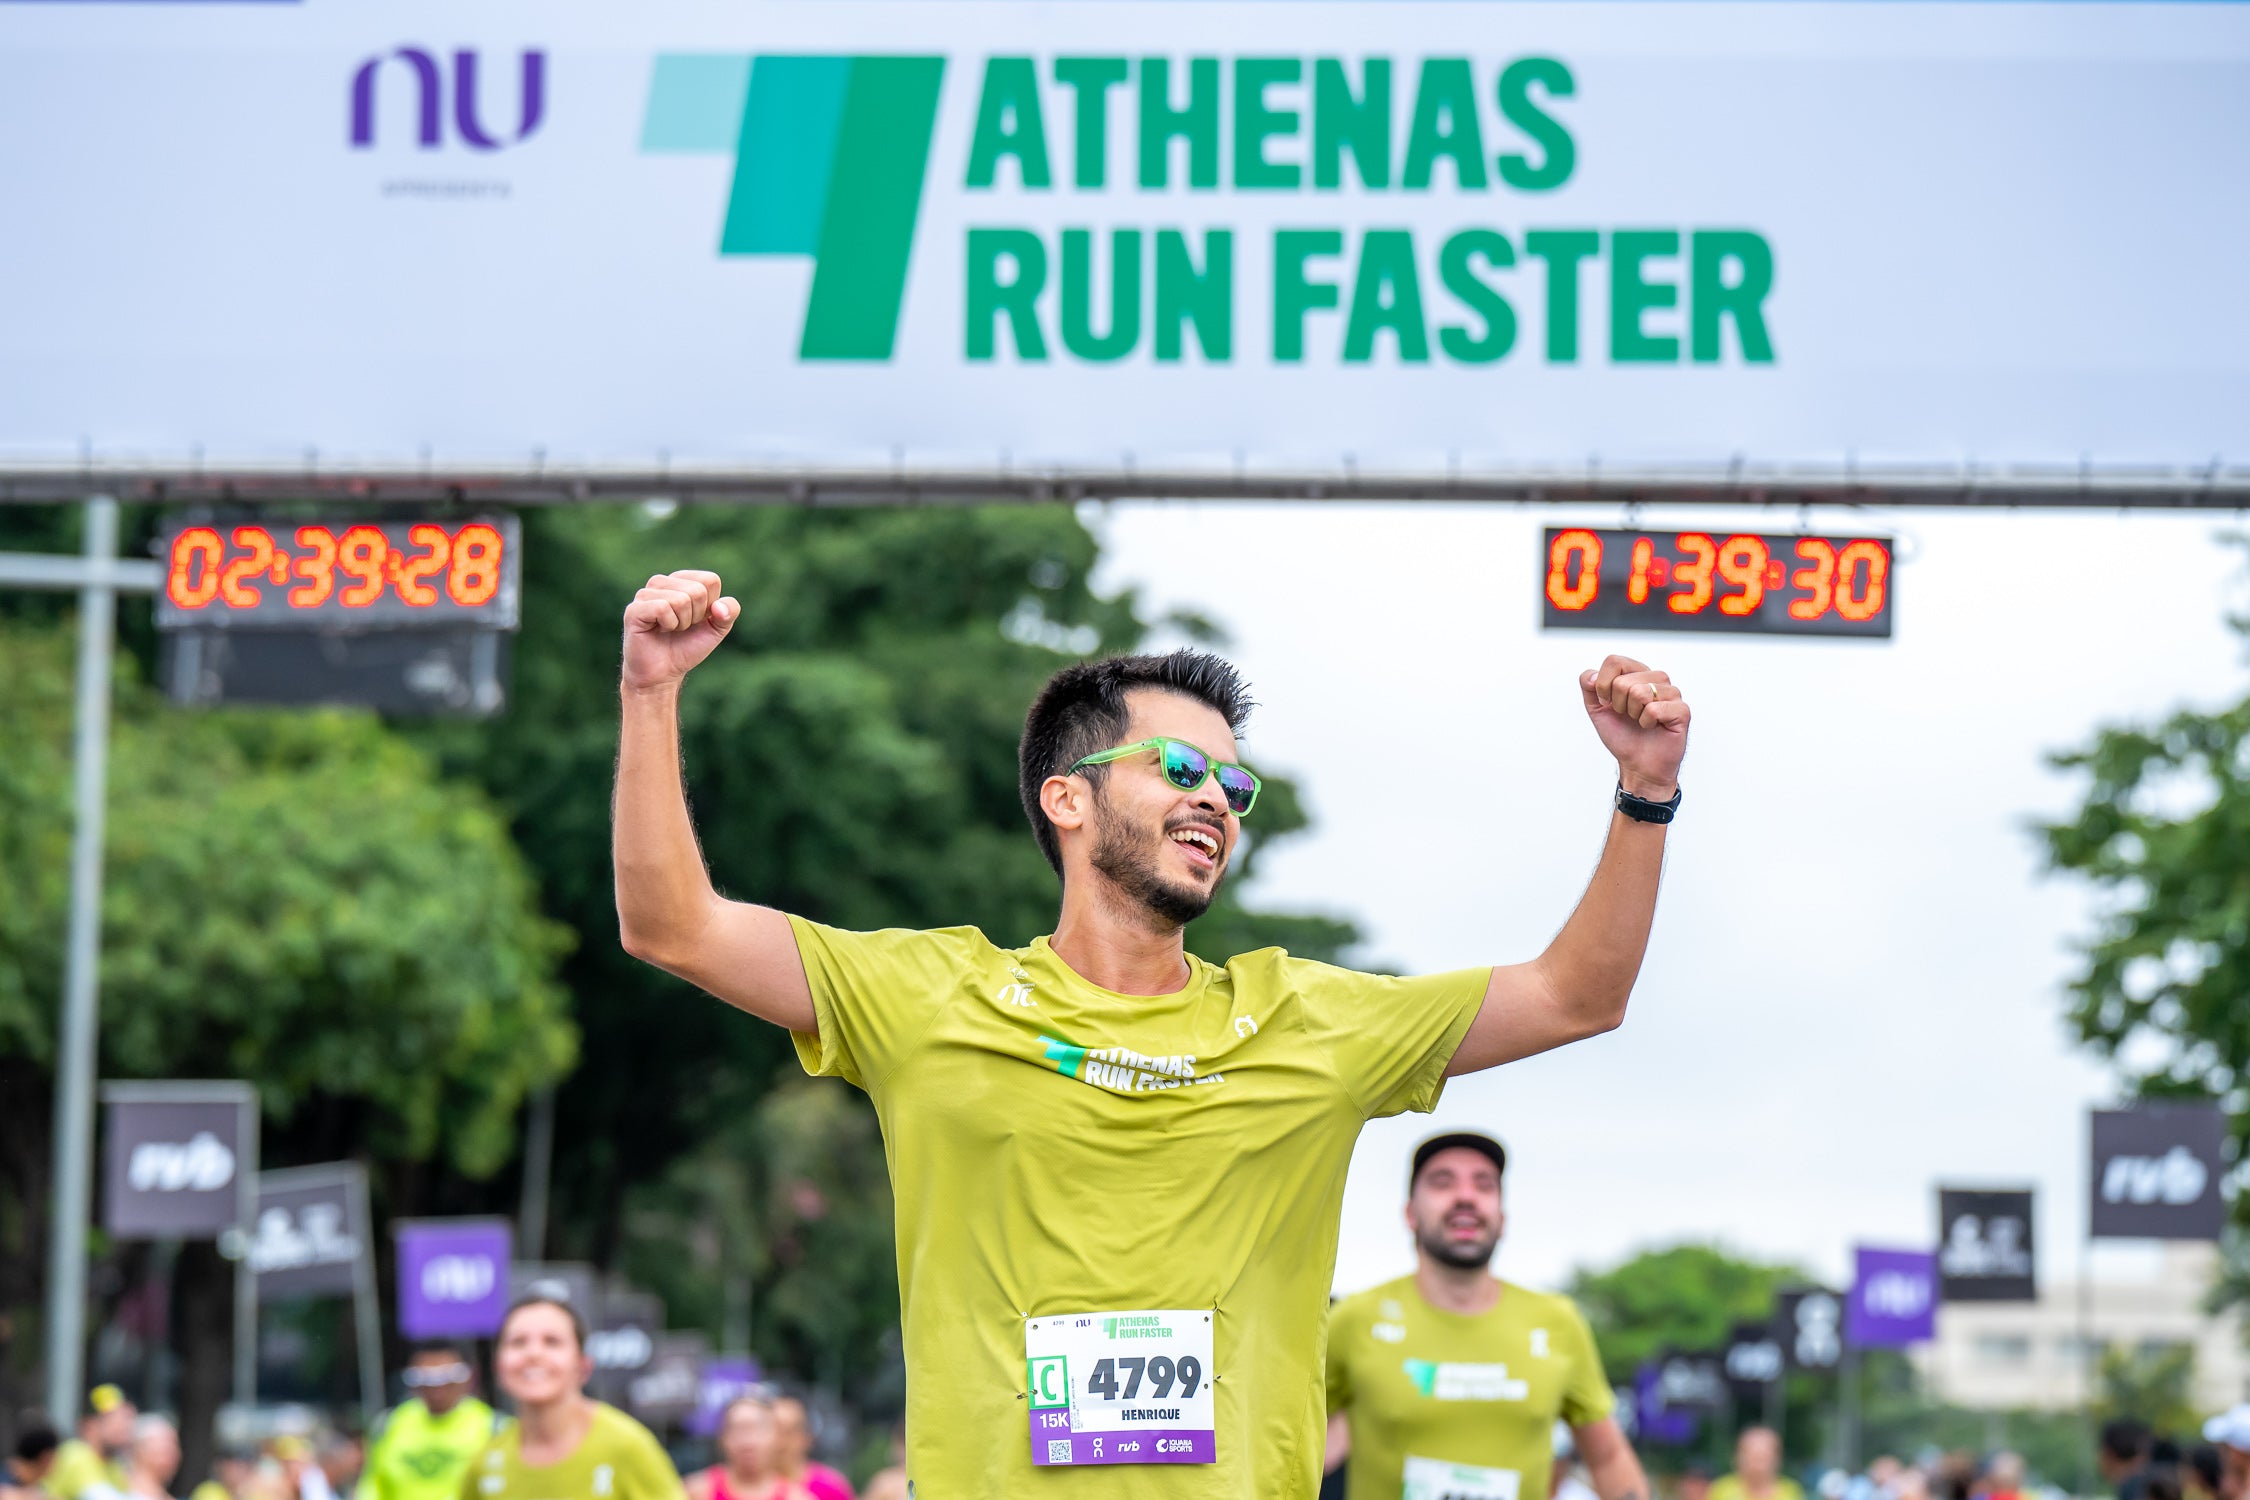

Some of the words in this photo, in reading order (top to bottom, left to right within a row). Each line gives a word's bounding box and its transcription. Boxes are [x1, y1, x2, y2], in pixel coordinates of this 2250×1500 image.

[965, 57, 1577, 191] ATHENAS
[965, 229, 1233, 363] RUN
[1273, 229, 1776, 364] FASTER
[167, 523, 503, 609] 02:39:28
[1546, 528, 1890, 621] 01:39:30
[1085, 1060, 1135, 1091] RUN
[1119, 1316, 1160, 1327] ATHENAS
[1119, 1328, 1138, 1339] RUN
[1139, 1328, 1173, 1338] FASTER
[1040, 1364, 1057, 1401] C
[1088, 1355, 1202, 1401] 4799
[1040, 1412, 1069, 1428] 15K
[1121, 1408, 1180, 1421] HENRIQUE
[1118, 1441, 1140, 1452] rvb
